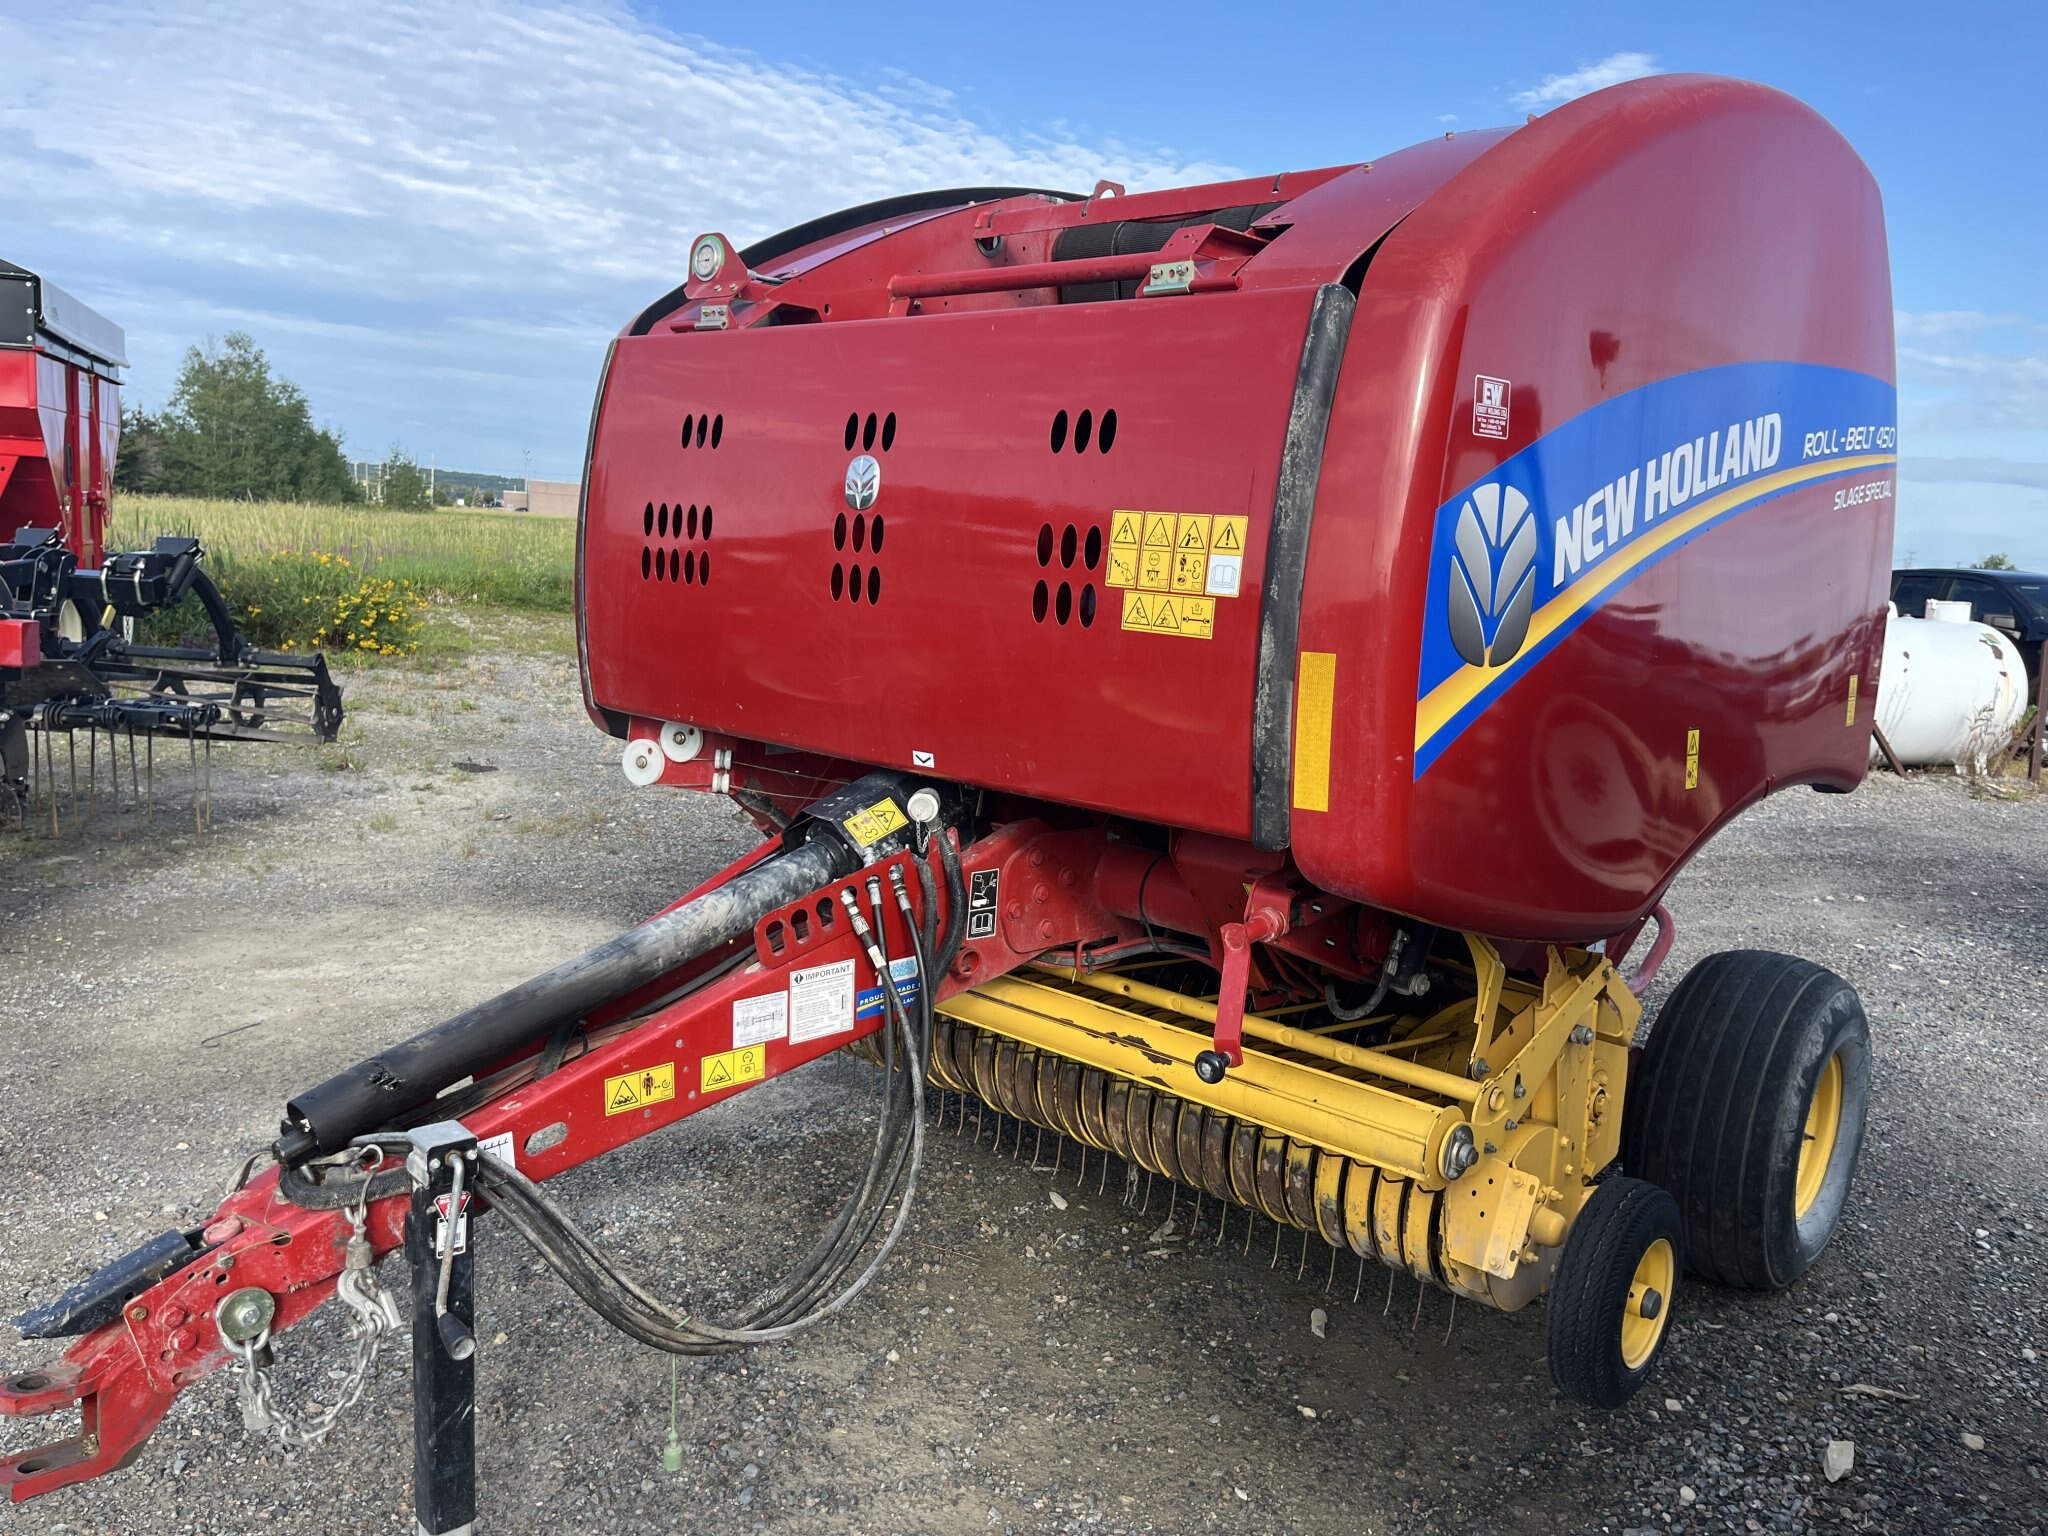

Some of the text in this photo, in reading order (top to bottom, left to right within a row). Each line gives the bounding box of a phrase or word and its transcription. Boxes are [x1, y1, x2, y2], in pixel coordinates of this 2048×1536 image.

[1483, 381, 1504, 407] EW
[1876, 426, 1896, 449] 450
[1553, 412, 1782, 588] NEW HOLLAND
[1833, 480, 1892, 511] SILAGE SPECIAL
[805, 964, 851, 981] IMPORTANT
